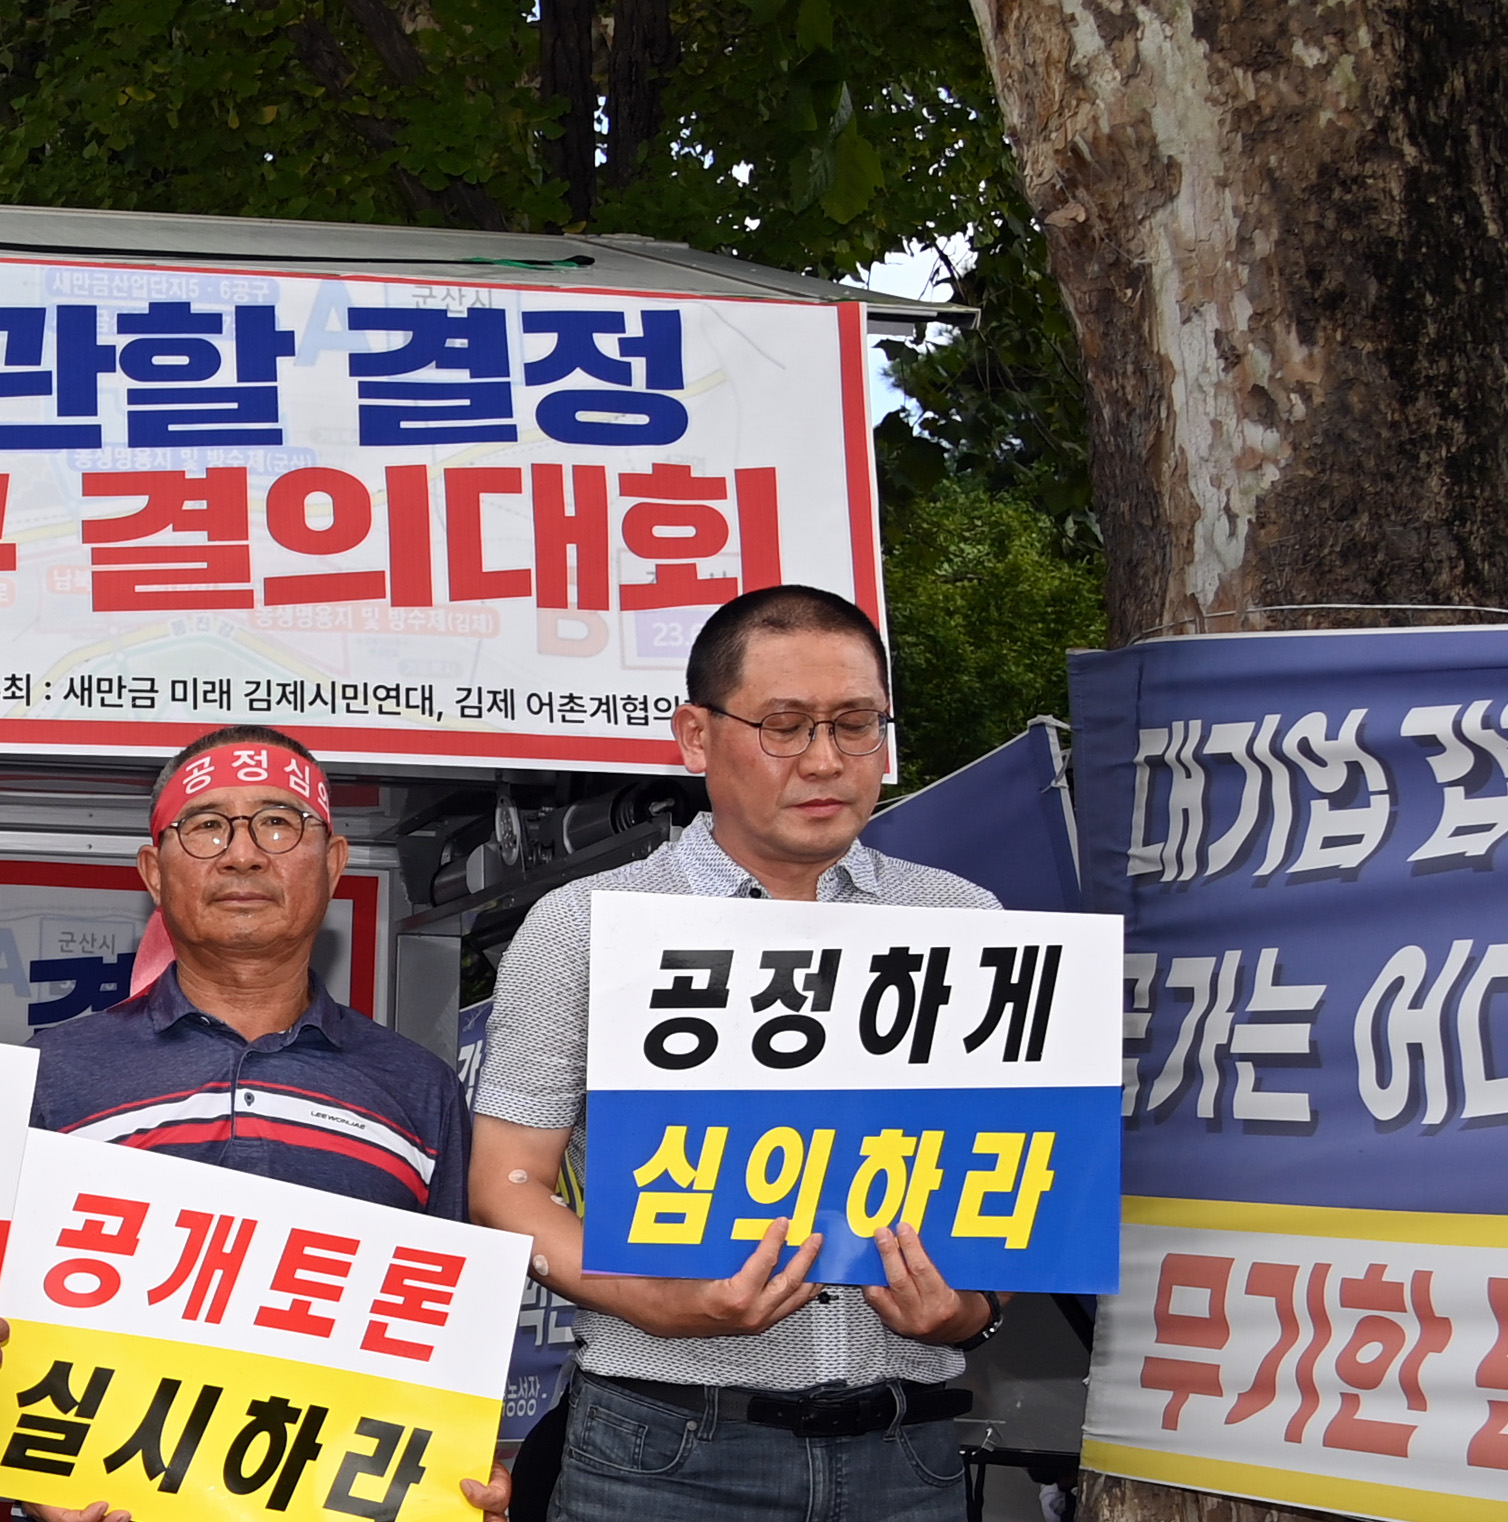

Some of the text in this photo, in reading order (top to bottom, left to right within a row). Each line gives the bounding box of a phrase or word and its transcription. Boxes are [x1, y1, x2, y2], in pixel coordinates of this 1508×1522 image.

[347, 304, 690, 447] 결정
[81, 463, 784, 613] 결의대회
[63, 674, 160, 710] 새만금
[171, 676, 232, 711] 미래
[243, 678, 443, 723] 김제시민연대,
[454, 685, 516, 721] 김제
[1126, 708, 1389, 881] 대기업
[642, 945, 1062, 1070] 공정하게
[627, 1126, 1054, 1250] 심의하라
[43, 1193, 466, 1362] 공개토론
[1140, 1253, 1452, 1457] 무기한
